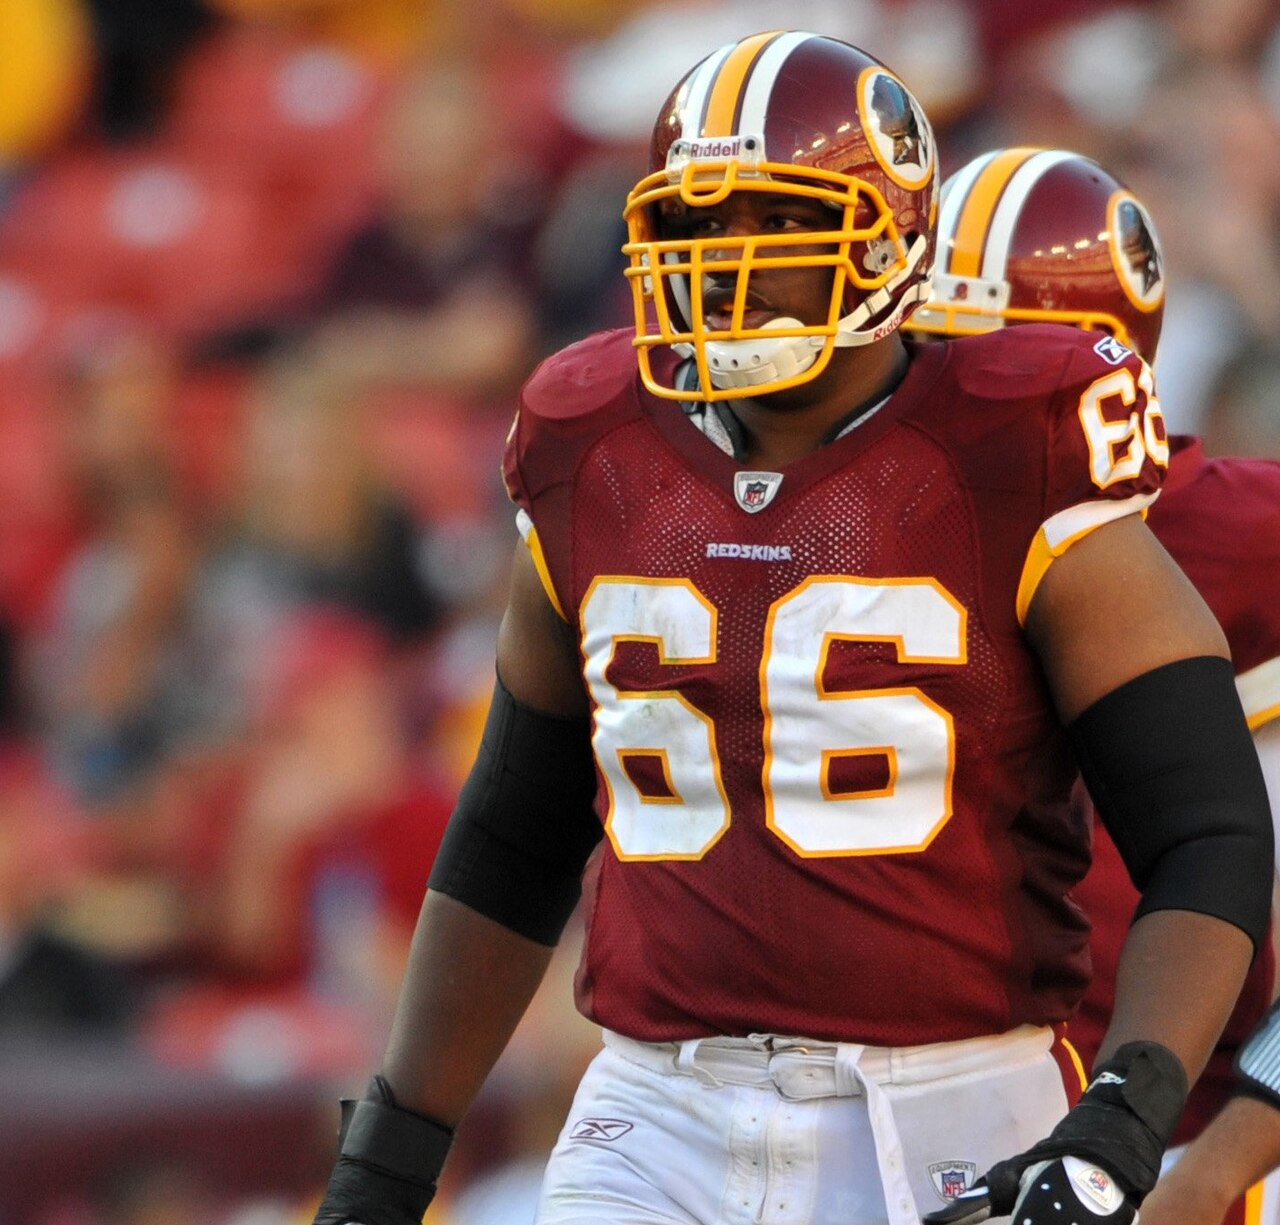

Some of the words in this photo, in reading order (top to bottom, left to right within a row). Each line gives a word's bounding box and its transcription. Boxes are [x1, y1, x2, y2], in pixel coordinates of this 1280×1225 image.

[690, 139, 741, 158] Riddell
[705, 543, 792, 561] REDSKINS
[579, 574, 968, 862] 66
